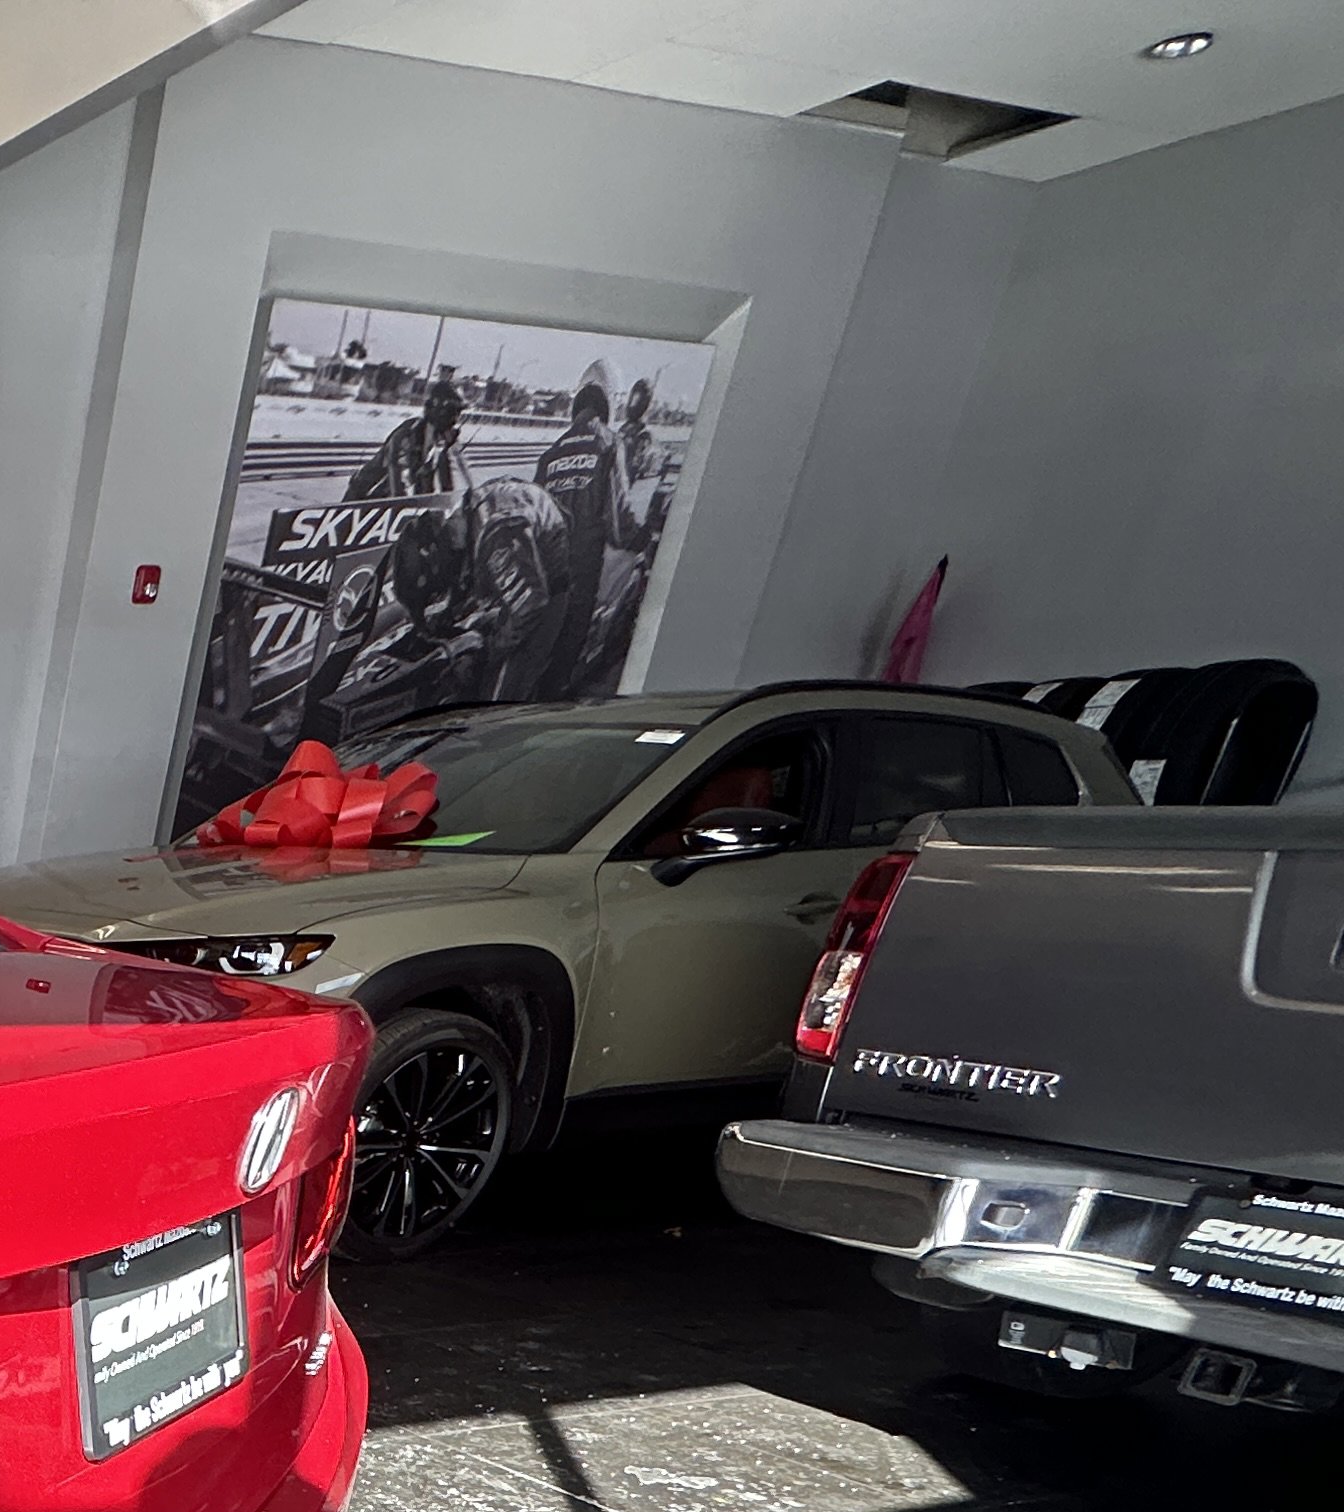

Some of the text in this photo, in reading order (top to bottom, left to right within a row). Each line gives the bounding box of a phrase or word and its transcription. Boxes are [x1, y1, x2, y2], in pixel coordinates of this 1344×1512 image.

[278, 508, 424, 551] SKYAC
[853, 1049, 1061, 1099] FRONTIER
[1252, 1194, 1314, 1213] Schwartz
[90, 1254, 230, 1364] SCHWARTZ
[1206, 1274, 1231, 1290] the
[1230, 1278, 1295, 1302] Schwartz
[1294, 1290, 1316, 1305] be
